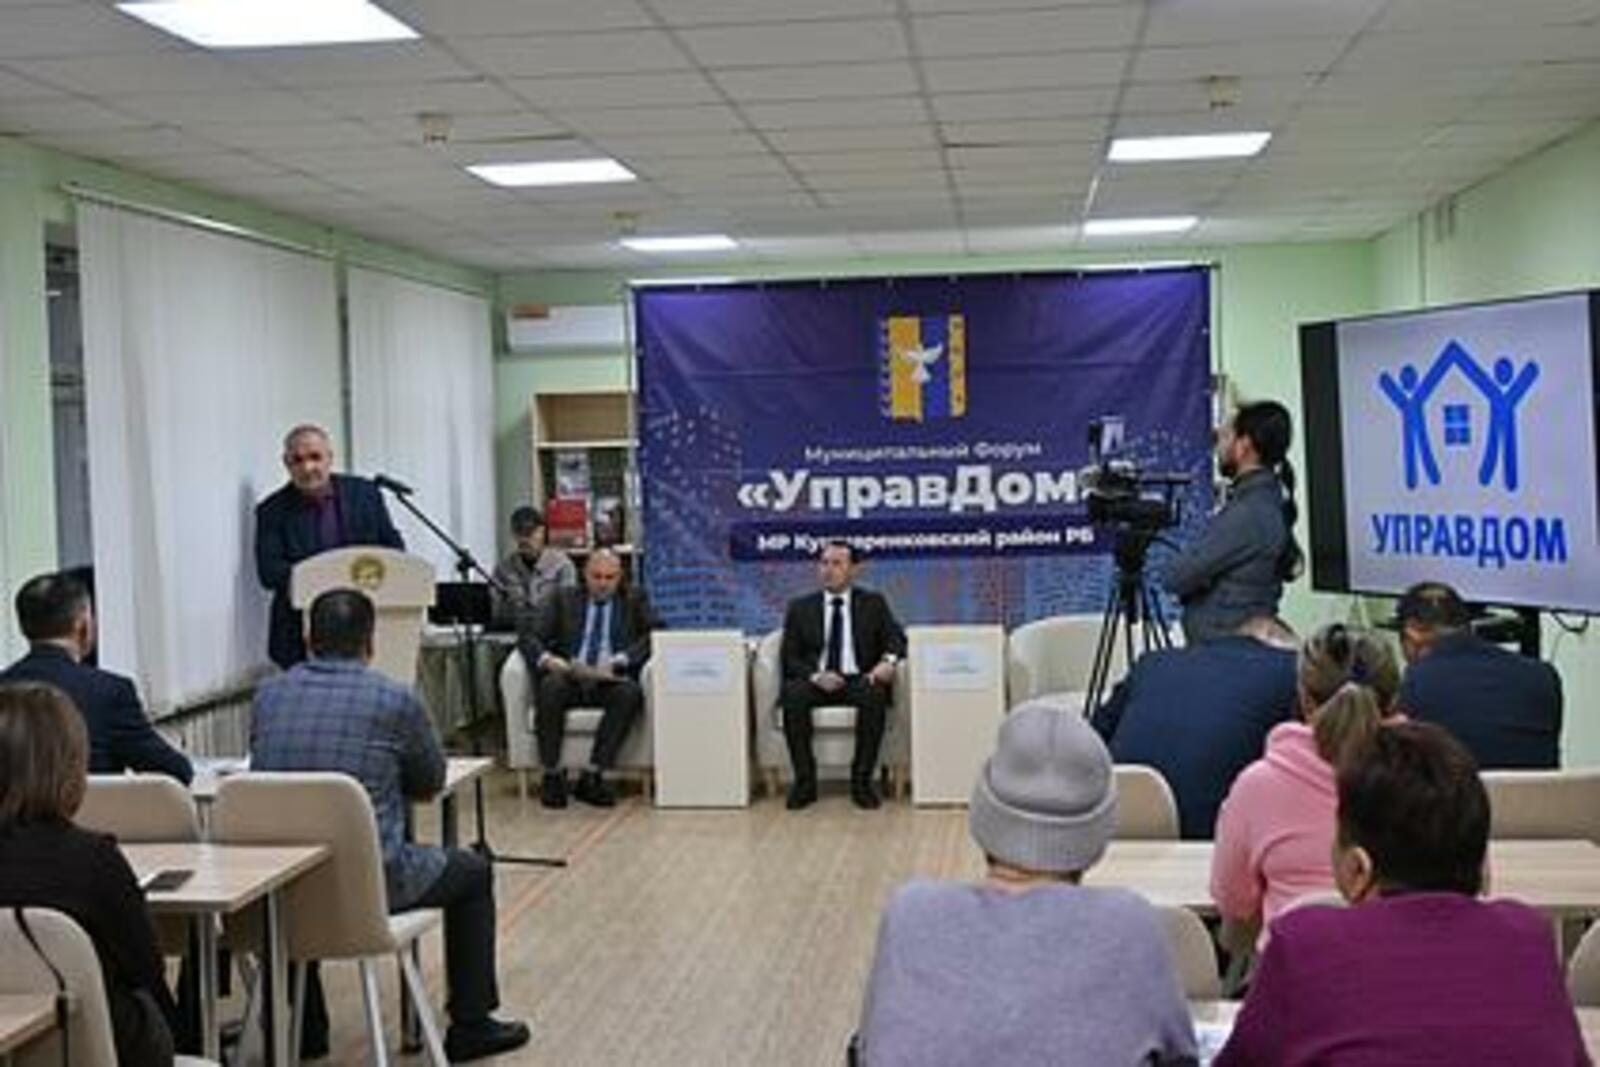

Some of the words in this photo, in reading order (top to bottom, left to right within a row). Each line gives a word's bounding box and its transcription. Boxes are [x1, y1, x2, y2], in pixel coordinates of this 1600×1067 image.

[805, 444, 969, 465] Муниципальный
[972, 441, 1042, 460] Форум
[737, 465, 1094, 519] «УправДом
[794, 529, 991, 554] Куаренковский
[996, 527, 1060, 550] район
[1066, 525, 1094, 543] РБ
[1371, 513, 1567, 568] УПРАВДОМ
